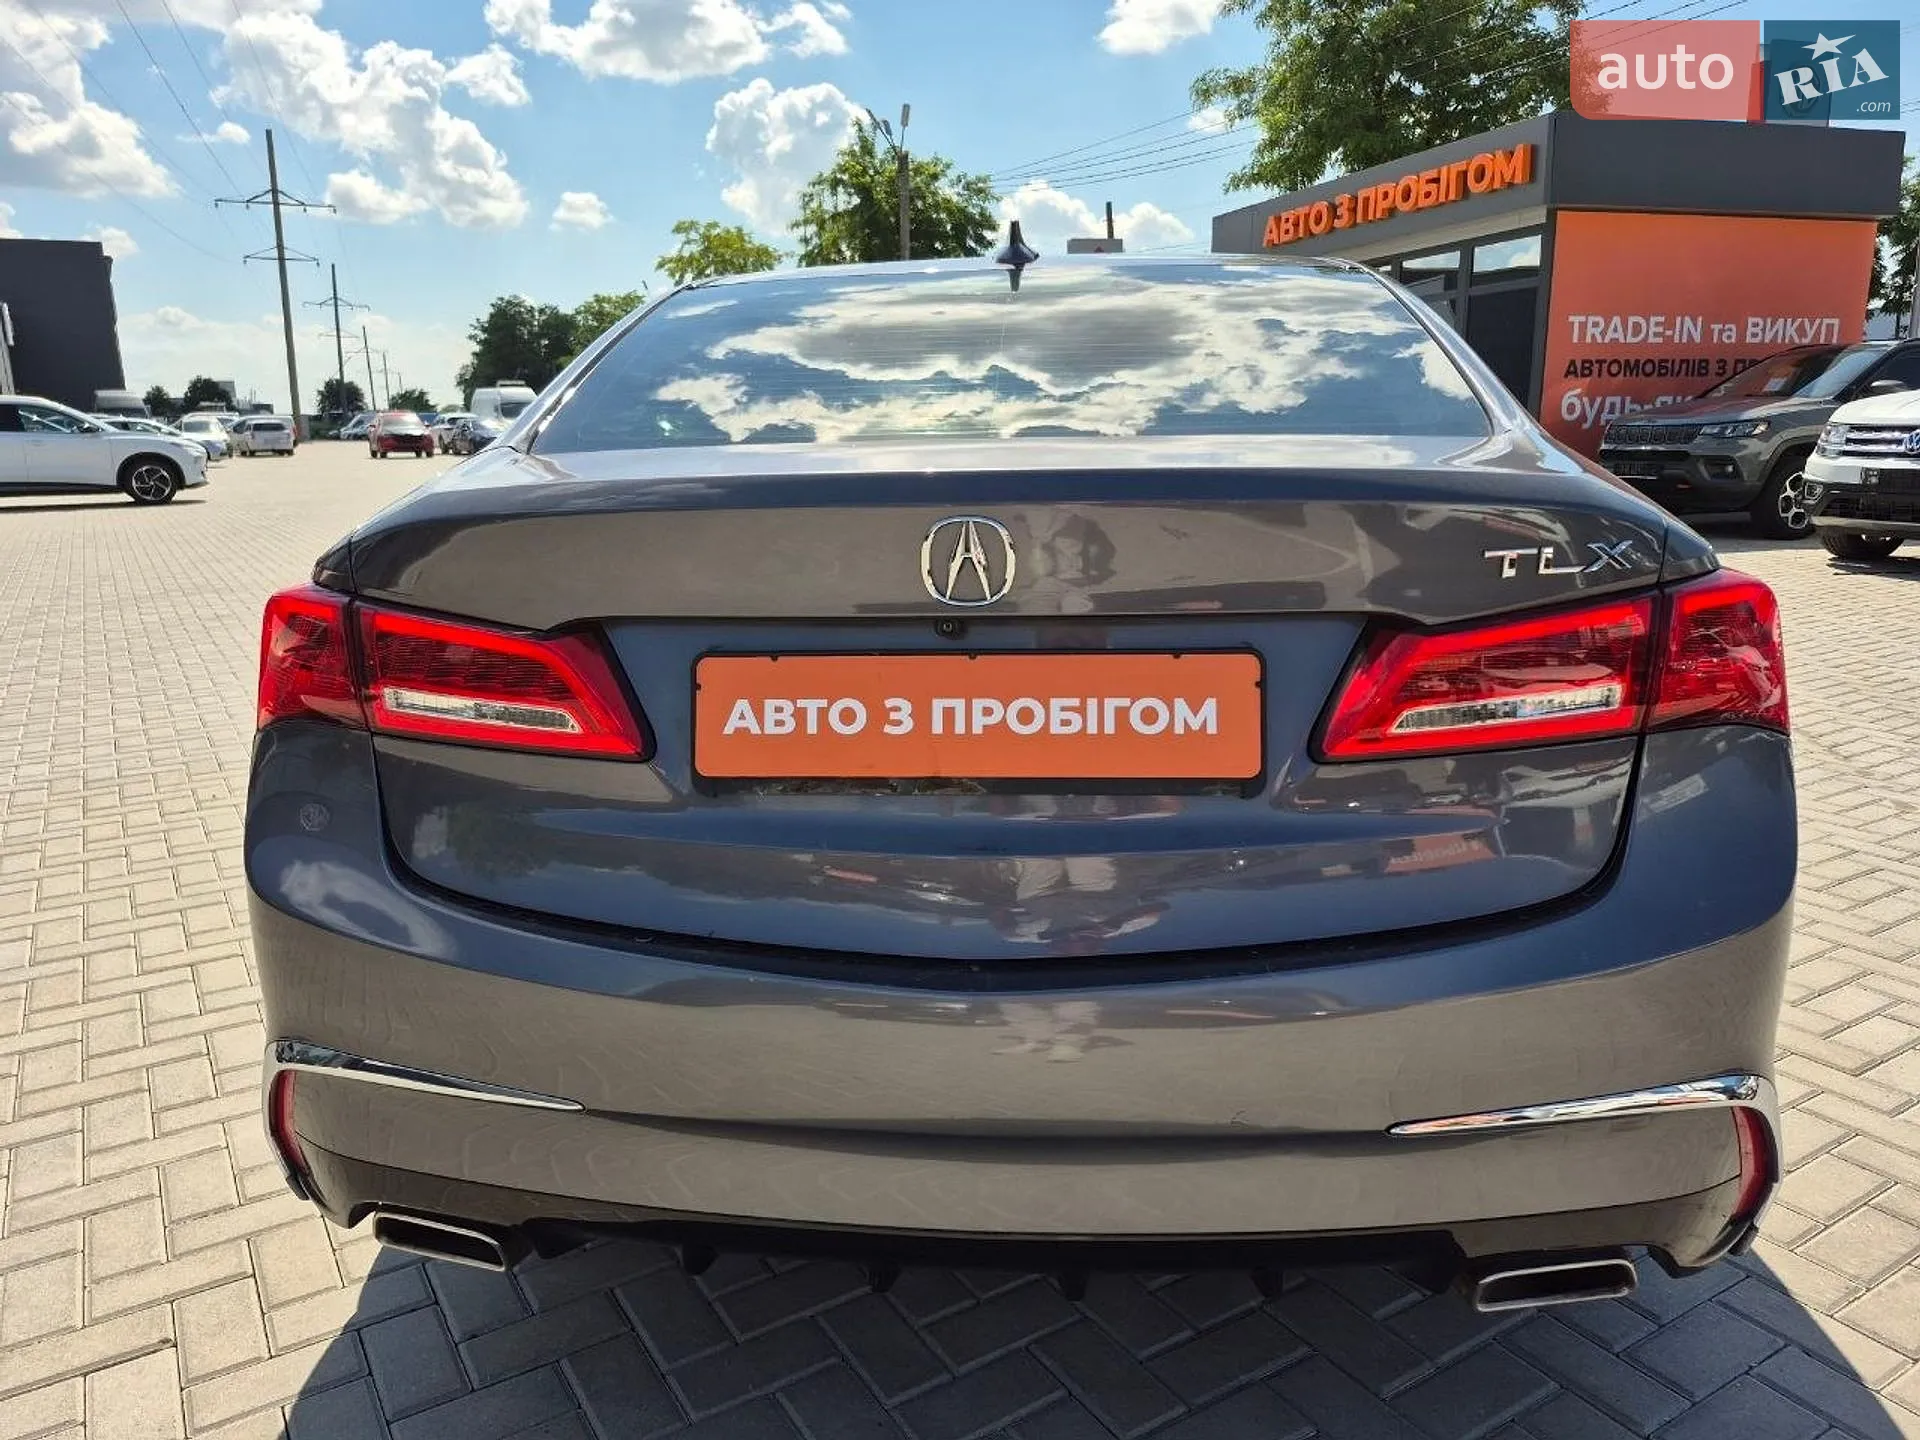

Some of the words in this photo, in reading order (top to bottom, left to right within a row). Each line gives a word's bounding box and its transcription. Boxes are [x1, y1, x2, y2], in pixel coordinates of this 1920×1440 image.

[1263, 201, 1335, 247] АВТО
[1357, 143, 1533, 223] ПРОБІГОМ
[1568, 315, 1702, 344] TRADE-IN
[1711, 323, 1736, 344] та
[1746, 316, 1840, 344] ВИКУП
[1564, 358, 1709, 379] АВТОМОБІЛІВ
[1484, 540, 1633, 579] TLX
[723, 698, 867, 736] АВТО
[931, 697, 1218, 735] ПРОБІГОМ
